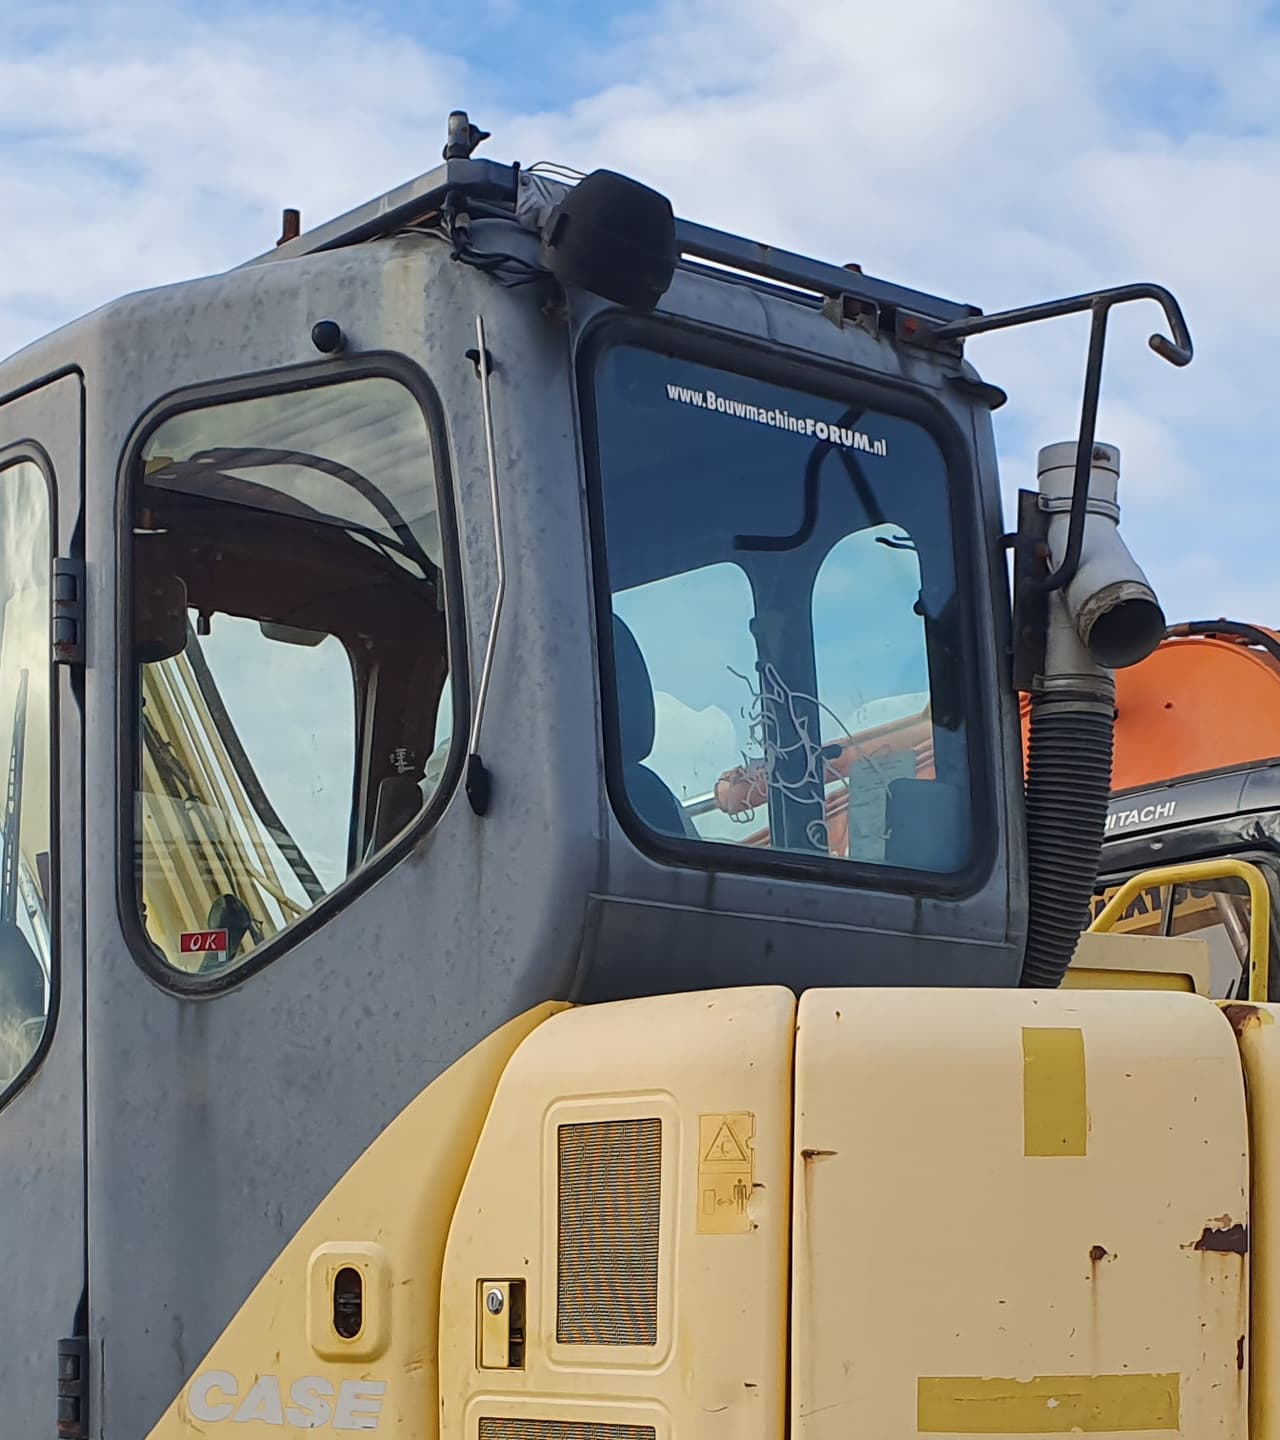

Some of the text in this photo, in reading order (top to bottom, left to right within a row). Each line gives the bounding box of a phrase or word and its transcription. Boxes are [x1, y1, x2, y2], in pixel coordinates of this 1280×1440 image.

[666, 383, 888, 458] www.BouwmachineFORUM.nl
[190, 933, 217, 951] OK
[187, 1369, 387, 1431] CASE
